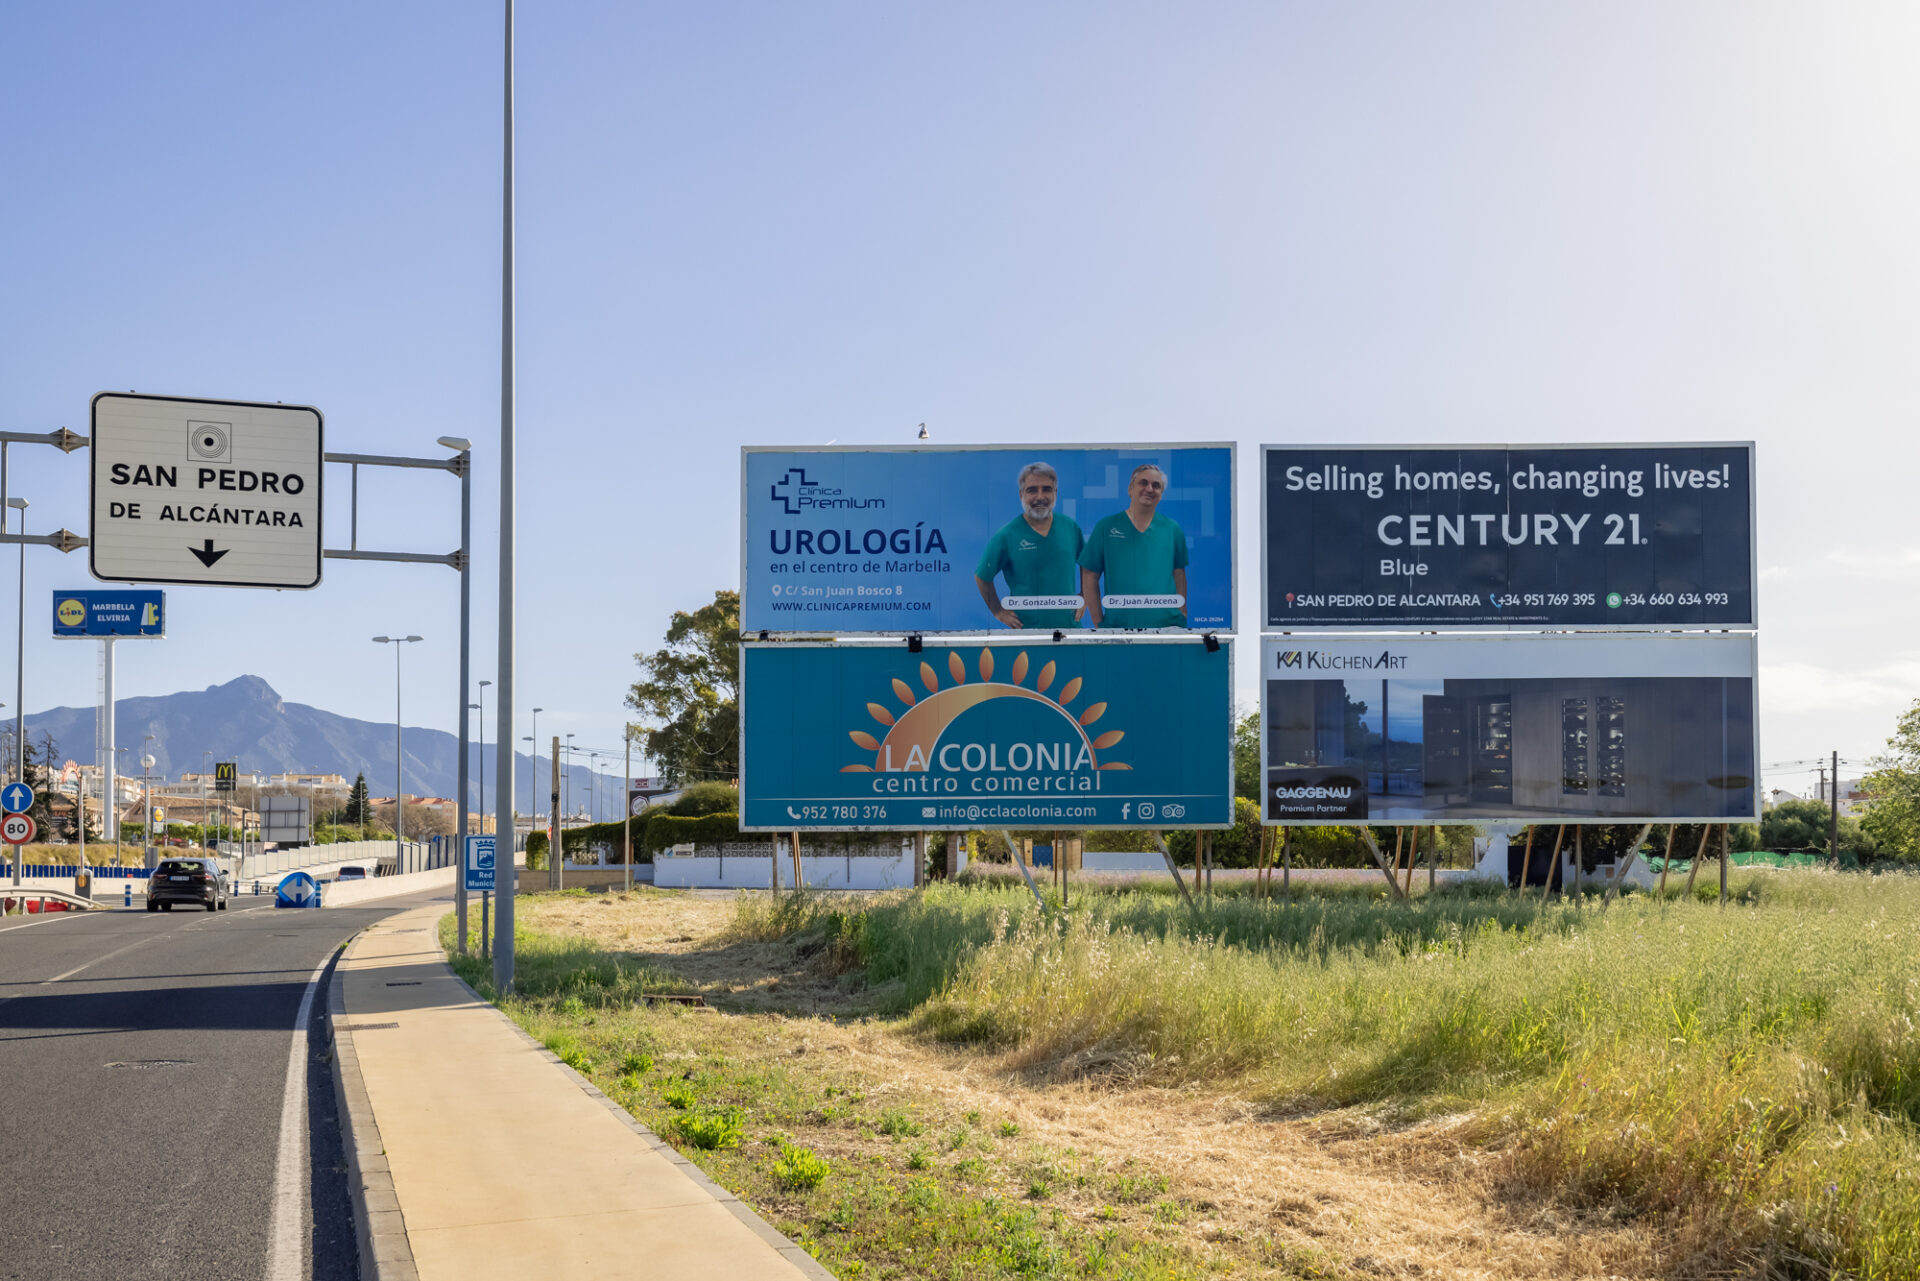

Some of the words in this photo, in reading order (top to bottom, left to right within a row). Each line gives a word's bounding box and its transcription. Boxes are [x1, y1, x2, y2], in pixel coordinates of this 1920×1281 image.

[109, 463, 177, 487] SAN
[198, 467, 305, 495] PEDRO
[1285, 465, 1384, 499] Selling
[1395, 464, 1501, 495] homes,
[1512, 463, 1644, 497] changing
[1655, 462, 1730, 489] lives!
[798, 496, 885, 509] Premium
[110, 502, 141, 519] DE
[159, 503, 304, 528] ALCÁNTARA
[1377, 513, 1592, 546] CENTURY
[770, 521, 948, 555] UROLOGÍA
[770, 562, 788, 573] en
[793, 560, 805, 573] el
[810, 561, 858, 573] centro
[862, 560, 881, 573] de
[885, 559, 950, 573] Marbella
[1380, 558, 1429, 576] Blue
[785, 585, 798, 597] C/
[801, 585, 823, 596] San
[825, 585, 854, 598] Juan
[857, 585, 893, 596] Bosco
[895, 585, 903, 596] 8
[1058, 598, 1077, 606] Sanz
[1109, 597, 1122, 605] Dr.
[1123, 597, 1142, 606] Juan
[1143, 597, 1178, 605] Arocena
[1297, 594, 1325, 607] SAN
[1328, 594, 1374, 607] PEDRO
[1377, 594, 1396, 607] DE
[1399, 594, 1481, 607] ALCANTARA
[1498, 594, 1521, 606] +34
[1524, 594, 1545, 606] 951
[1547, 594, 1570, 606] 769
[1572, 593, 1596, 606] 395
[1623, 593, 1646, 606] +34
[1649, 593, 1674, 606] 660
[1678, 593, 1702, 605] 634
[1704, 592, 1729, 605] 993
[92, 603, 136, 611] MARBELLA
[772, 602, 932, 612] WWW.CLINICAPREMIUM.COM
[97, 614, 131, 622] ELVIRIA
[885, 744, 930, 772] LA
[938, 742, 1096, 772] COLONIA
[872, 775, 958, 793] centro
[970, 770, 1100, 793] comercial
[1275, 786, 1352, 799] GAGGENAU
[802, 806, 828, 819] 952
[832, 806, 858, 819] 780
[863, 805, 887, 819] 376
[939, 804, 1097, 821] info@cclacolonia.com
[1280, 804, 1315, 812] Premium
[1316, 804, 1347, 812] Partner
[7, 823, 26, 834] 80
[479, 871, 493, 879] Red
